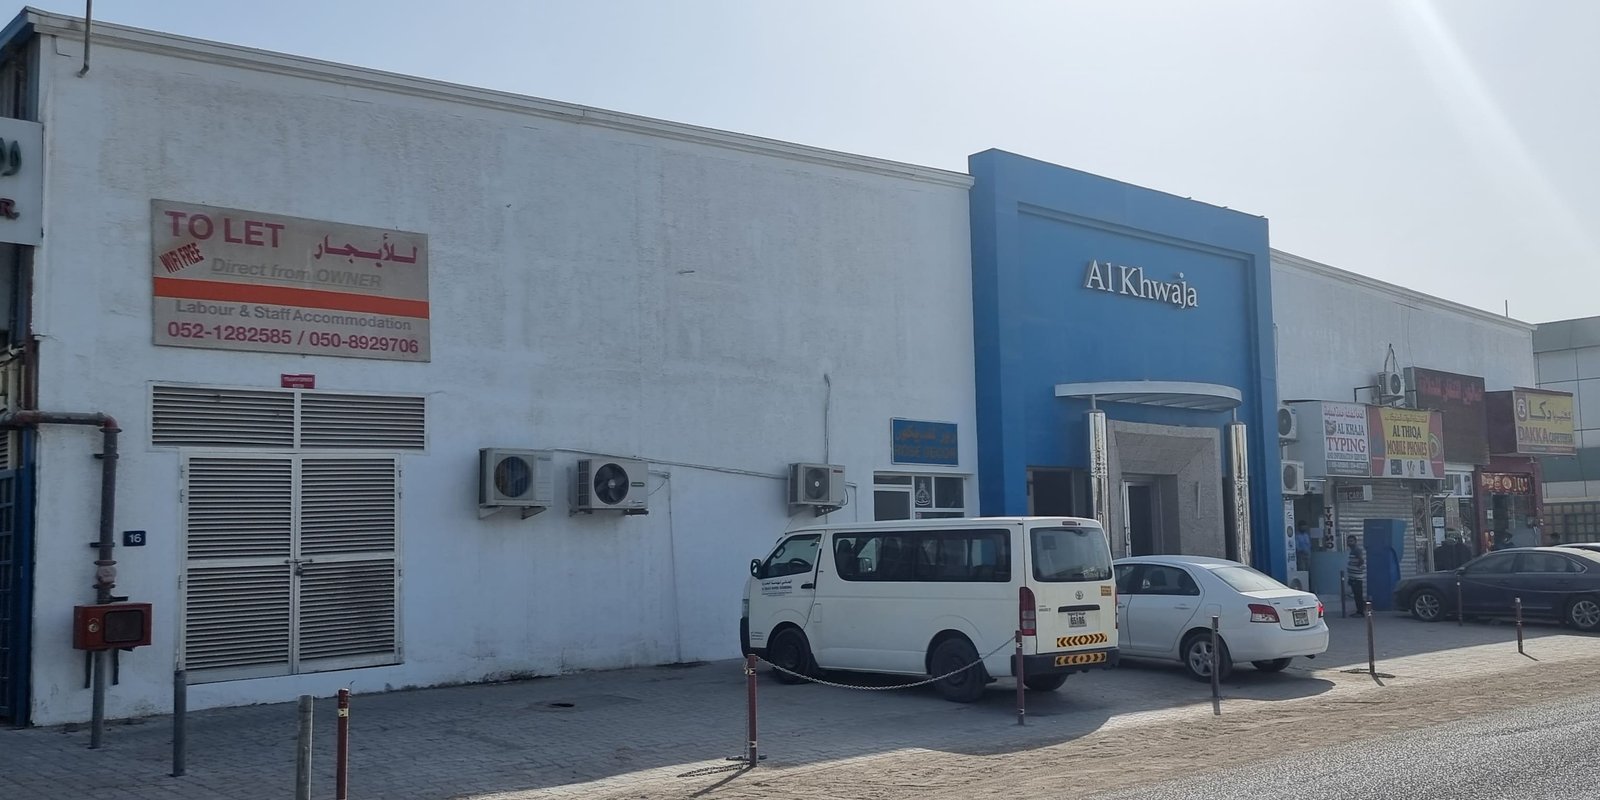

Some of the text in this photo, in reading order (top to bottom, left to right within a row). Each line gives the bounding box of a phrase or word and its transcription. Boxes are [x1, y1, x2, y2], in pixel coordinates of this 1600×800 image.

[165, 211, 285, 248] TO LET
[159, 242, 205, 273] WIFI FREE
[211, 258, 382, 288] Direct from OWNER
[1086, 259, 1199, 309] Al Khwaja
[176, 300, 412, 331] Labour & Staff Accommodation
[167, 321, 292, 345] 052-1282585
[309, 331, 419, 354] 050-8929706
[1336, 423, 1345, 435] AL
[1392, 424, 1422, 439] AL THIQA
[1518, 426, 1549, 443] DAKKA
[1326, 436, 1366, 453] TYPING
[1387, 440, 1407, 455] MOBILE
[128, 533, 142, 543] 16
